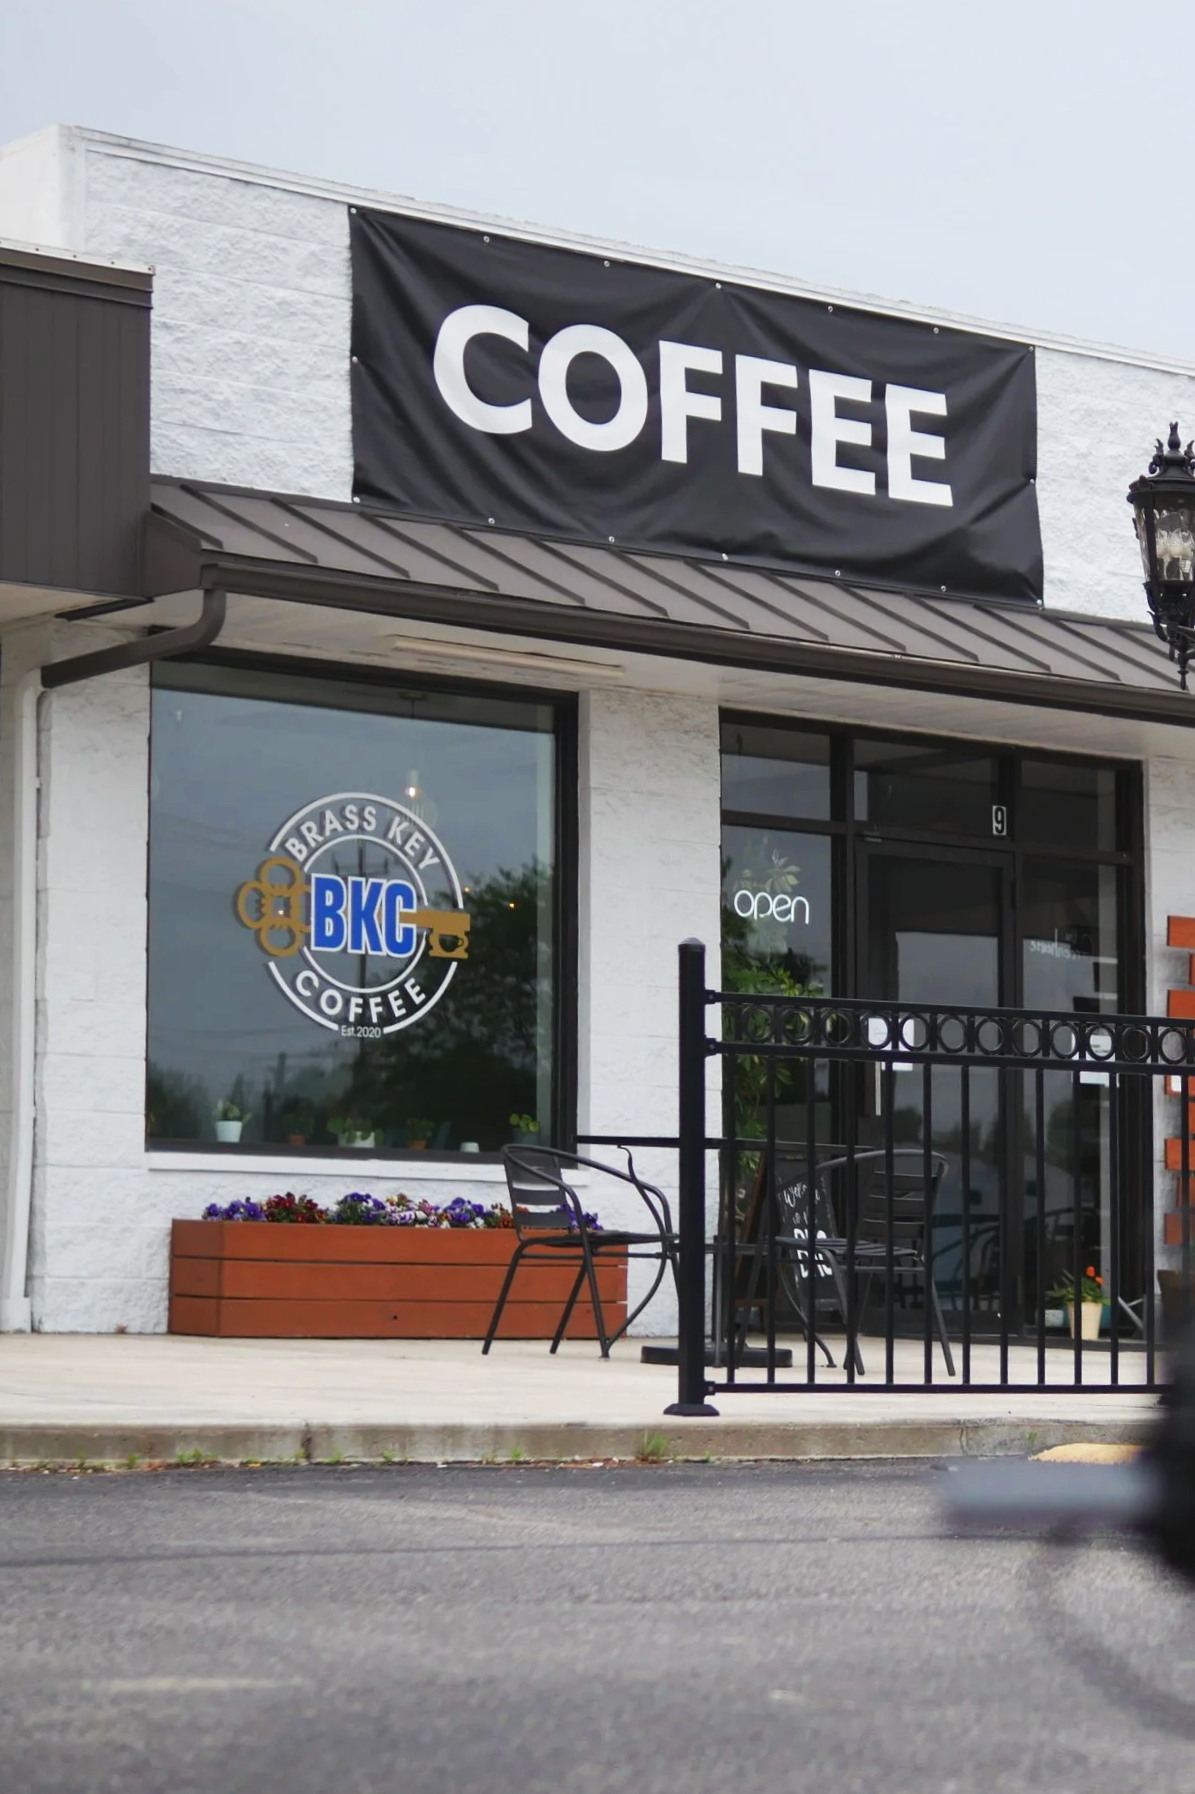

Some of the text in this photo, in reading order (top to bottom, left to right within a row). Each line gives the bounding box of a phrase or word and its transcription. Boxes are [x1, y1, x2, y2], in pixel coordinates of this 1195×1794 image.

[433, 304, 952, 506] COFFEE
[284, 804, 440, 870] BRASS KEY
[995, 806, 1005, 834] 9
[310, 873, 417, 958] BKC
[734, 889, 809, 925] open
[296, 970, 426, 1023] COFFEE
